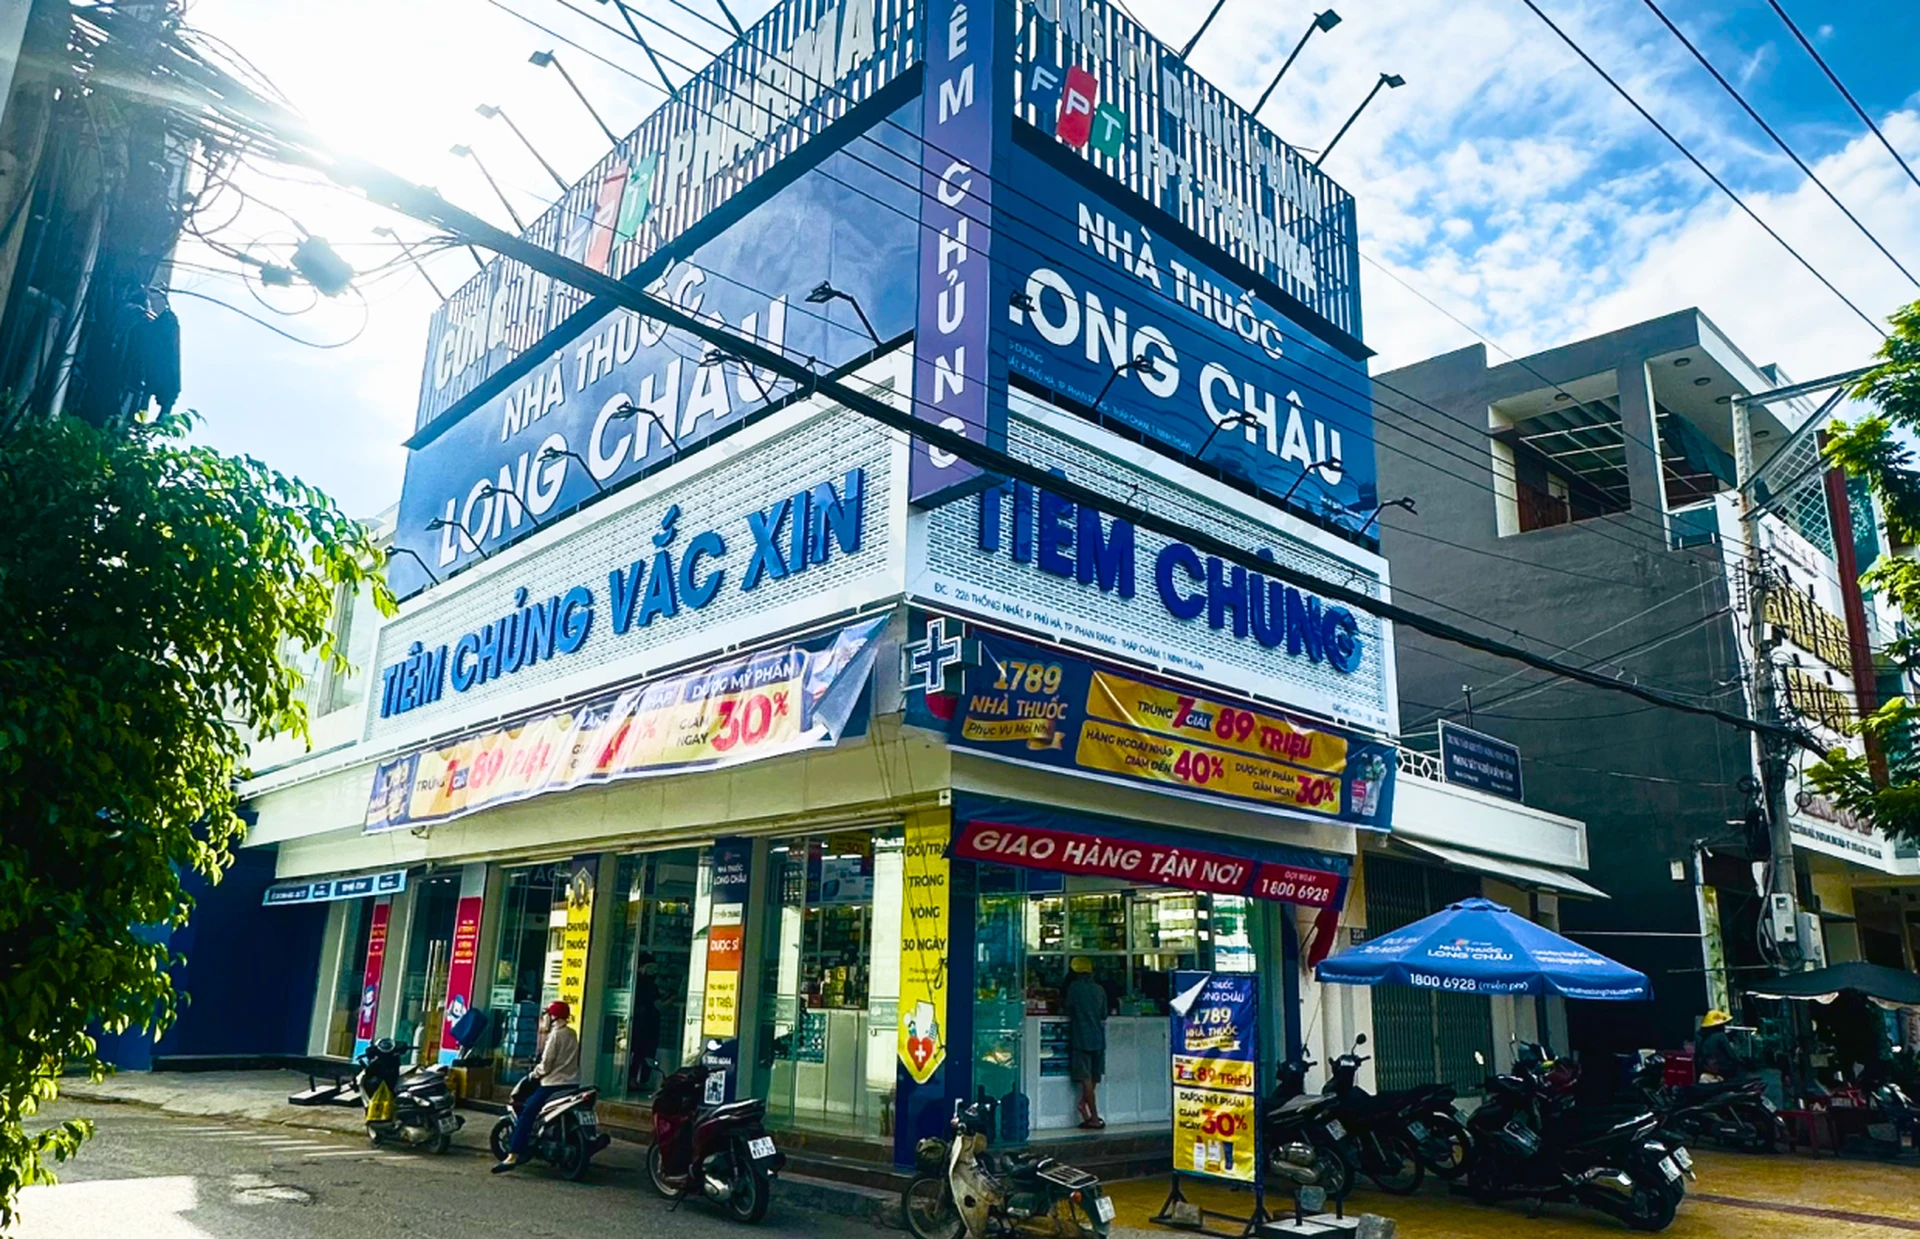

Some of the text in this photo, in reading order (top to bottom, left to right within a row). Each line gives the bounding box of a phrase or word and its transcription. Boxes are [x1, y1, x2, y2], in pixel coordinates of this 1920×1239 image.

[665, 0, 876, 212] PHARMA
[1028, 60, 1126, 150] FPT
[1078, 202, 1283, 360] NHÀ THUỐC
[1009, 267, 1343, 486] ONG CHÂU
[501, 350, 565, 441] NHÀ
[439, 432, 568, 568] LONG
[380, 467, 865, 719] TIÊM CHỦNG VẮC XIN
[993, 659, 1063, 695] 1789
[970, 690, 1069, 720] NHÀ THUỐC
[711, 690, 790, 752] 30%
[1172, 695, 1196, 729] 7
[1214, 707, 1256, 743] 89
[1259, 725, 1314, 762] TRIỆU
[1086, 727, 1116, 745] HÀNG
[1173, 749, 1225, 785] 40%
[1295, 775, 1336, 807] 30%
[972, 830, 1244, 886] GIAO HÀNG TẬN NƠI
[909, 875, 944, 888] TRONG
[1261, 877, 1330, 902] 1800 6928
[910, 903, 940, 919] VÒNG
[902, 932, 947, 951] 30 NGÀY
[1427, 949, 1514, 961] LONG CHÂU
[1464, 944, 1504, 954] THUỐC
[566, 957, 583, 969] THEO
[1211, 979, 1235, 990] THUỐC
[1221, 990, 1245, 1003] CHÂU
[1410, 973, 1441, 988] 1800
[1442, 977, 1477, 991] 6928
[1193, 1006, 1232, 1025] 1789
[1208, 1021, 1240, 1037] THUỐC
[1197, 1066, 1217, 1083] 89
[1201, 1109, 1248, 1138] 30%
